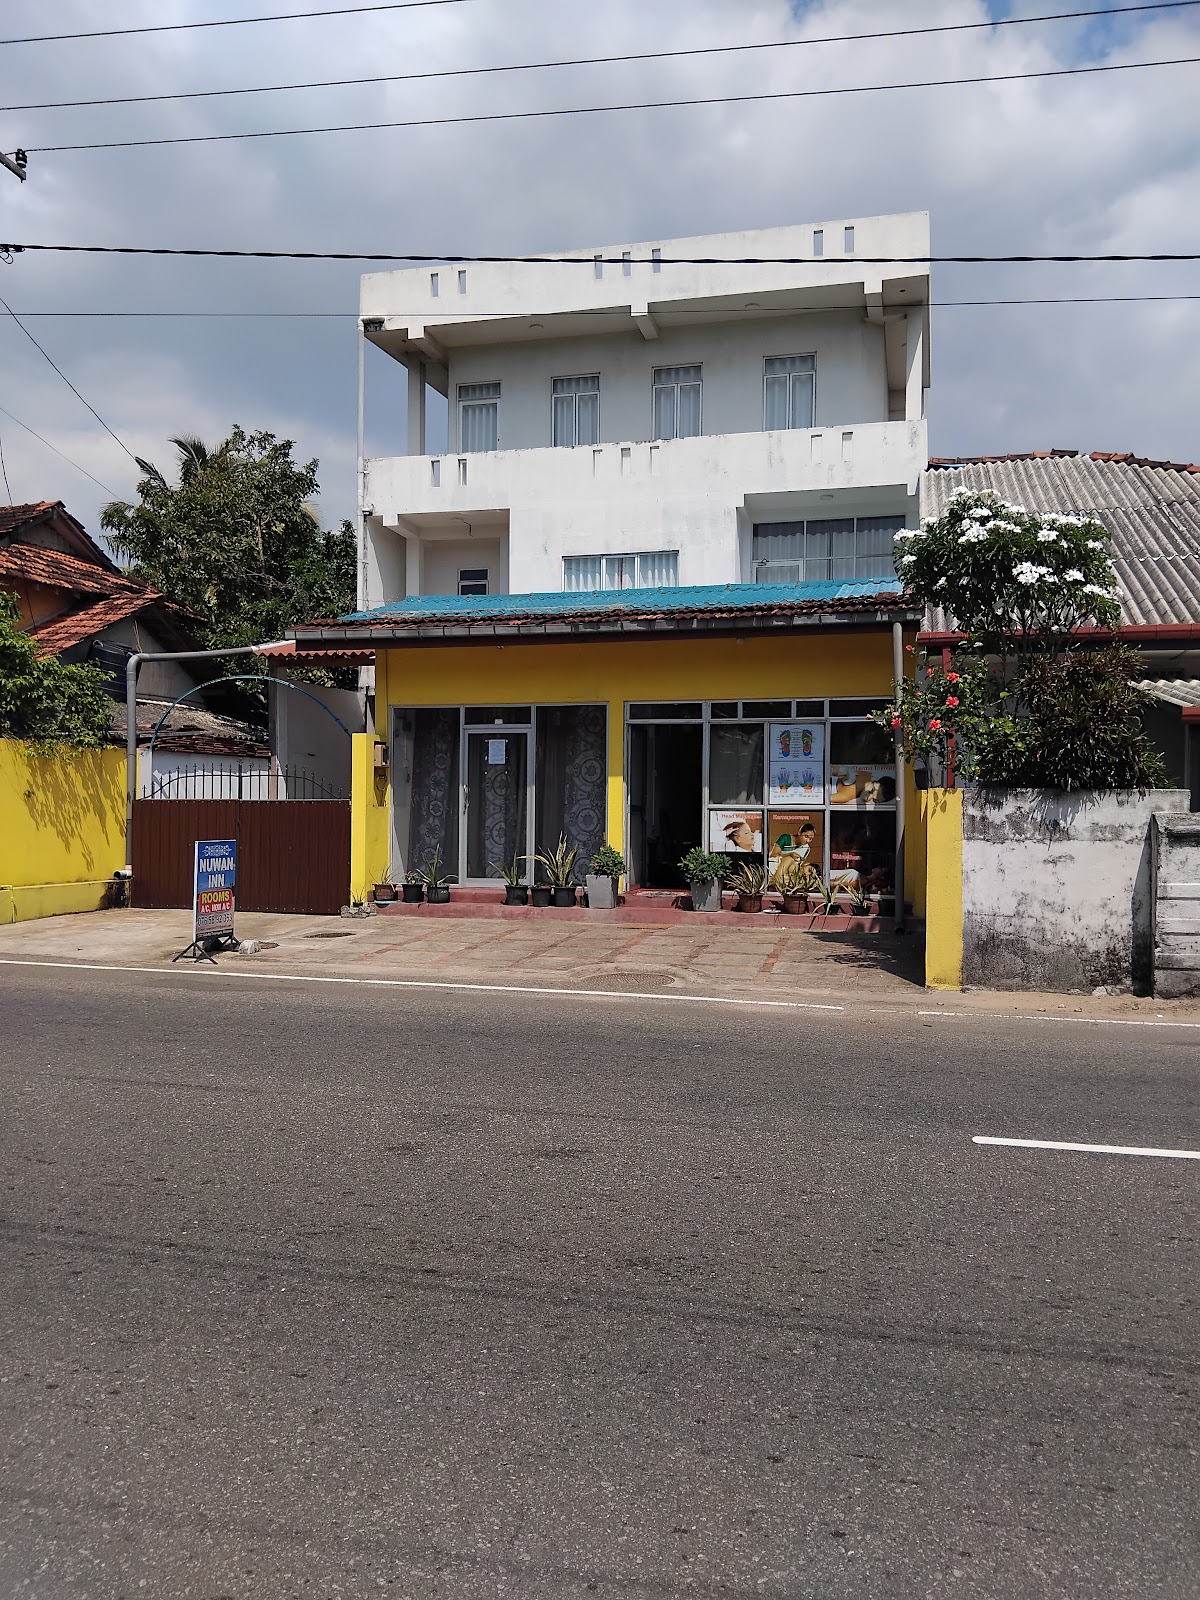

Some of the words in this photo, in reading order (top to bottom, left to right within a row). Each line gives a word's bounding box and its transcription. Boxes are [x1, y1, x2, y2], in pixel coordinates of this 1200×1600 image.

[199, 857, 234, 872] NUWAN
[208, 874, 225, 888] INN
[201, 891, 230, 904] ROOMS
